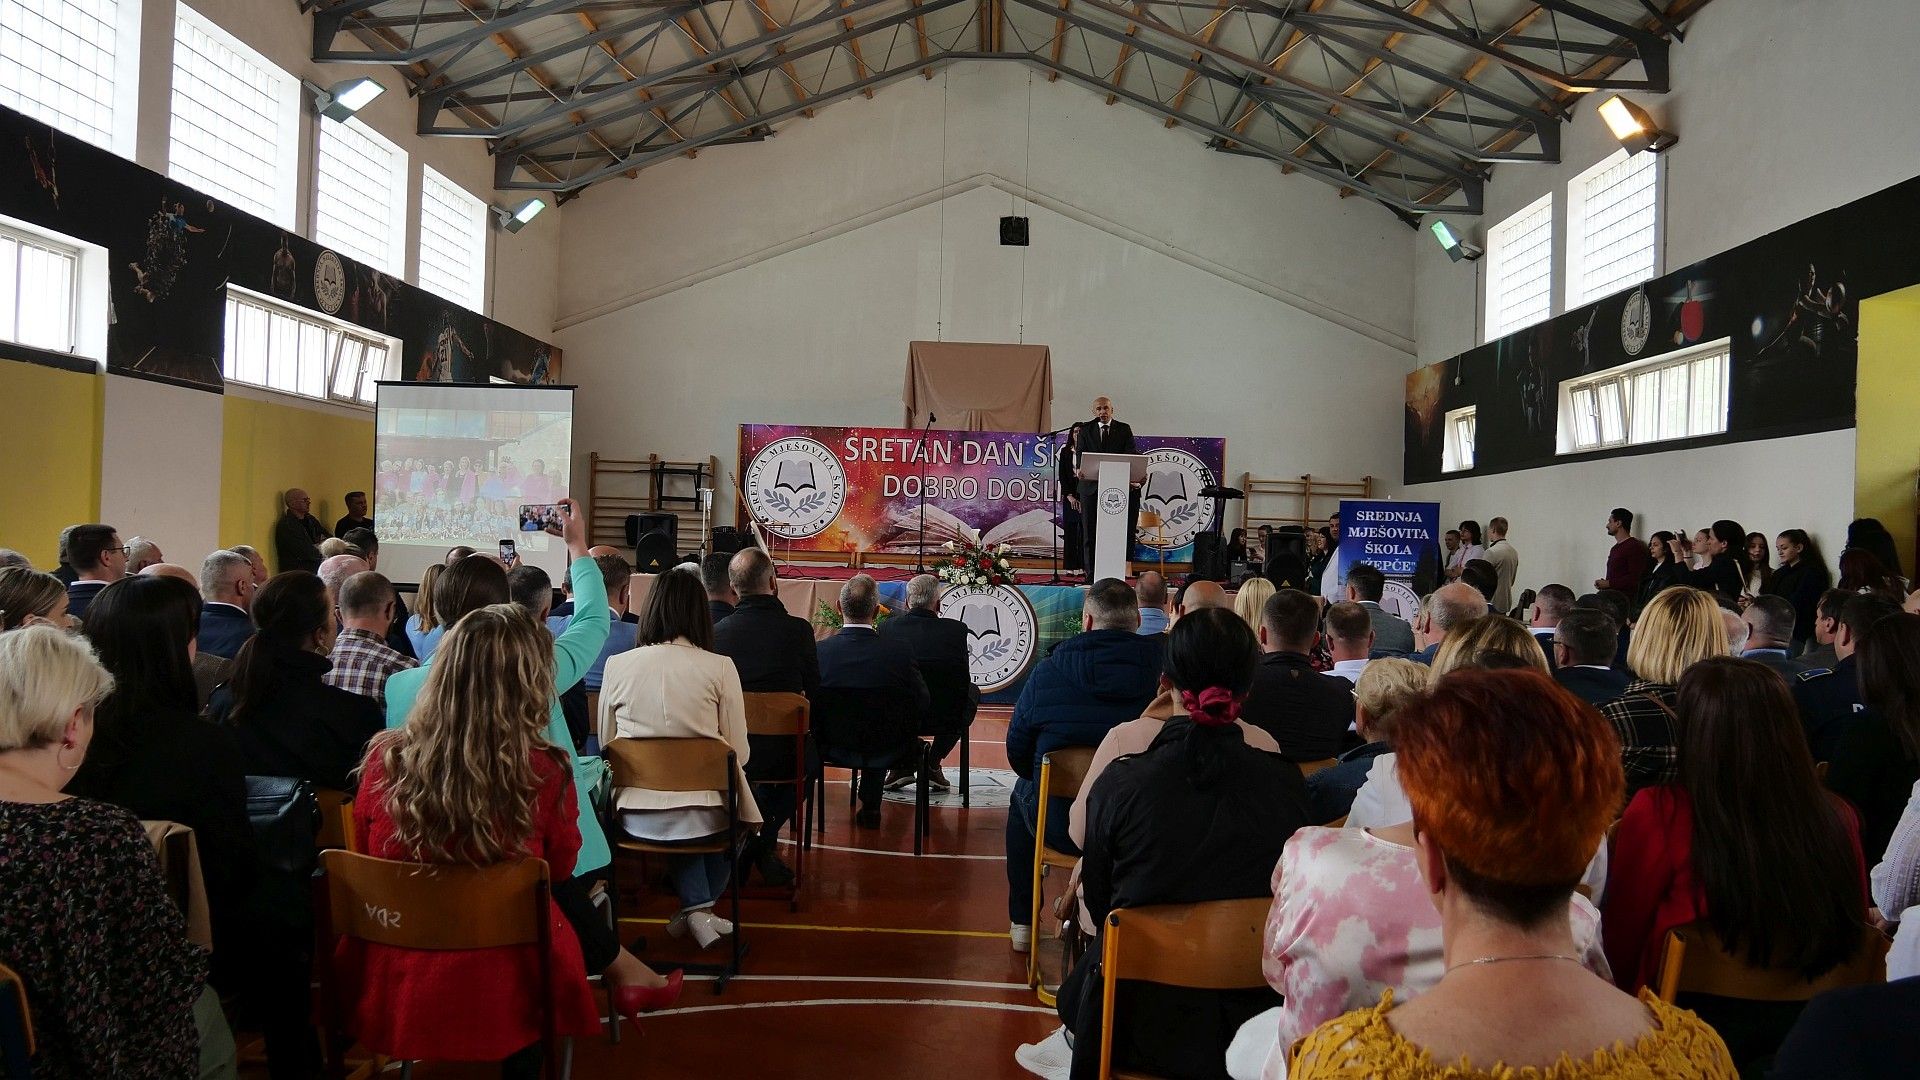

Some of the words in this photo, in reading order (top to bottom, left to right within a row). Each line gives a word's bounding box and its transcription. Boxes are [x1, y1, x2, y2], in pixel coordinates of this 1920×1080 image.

[844, 437, 951, 465] SRETAN
[962, 440, 1024, 467] DAN
[1032, 435, 1067, 468] ŠK
[750, 459, 767, 512] SREDNJA
[769, 441, 835, 471] MJEŠOVITA
[826, 475, 841, 514] ŠKOLA
[883, 474, 979, 500] DOBRO
[1356, 510, 1423, 523] SREDNJA
[779, 522, 820, 535] EPČE
[1347, 524, 1430, 540] MJEŠOVITA
[1364, 540, 1413, 556] ŠKOLA
[1010, 621, 1028, 663] ŠKOLA
